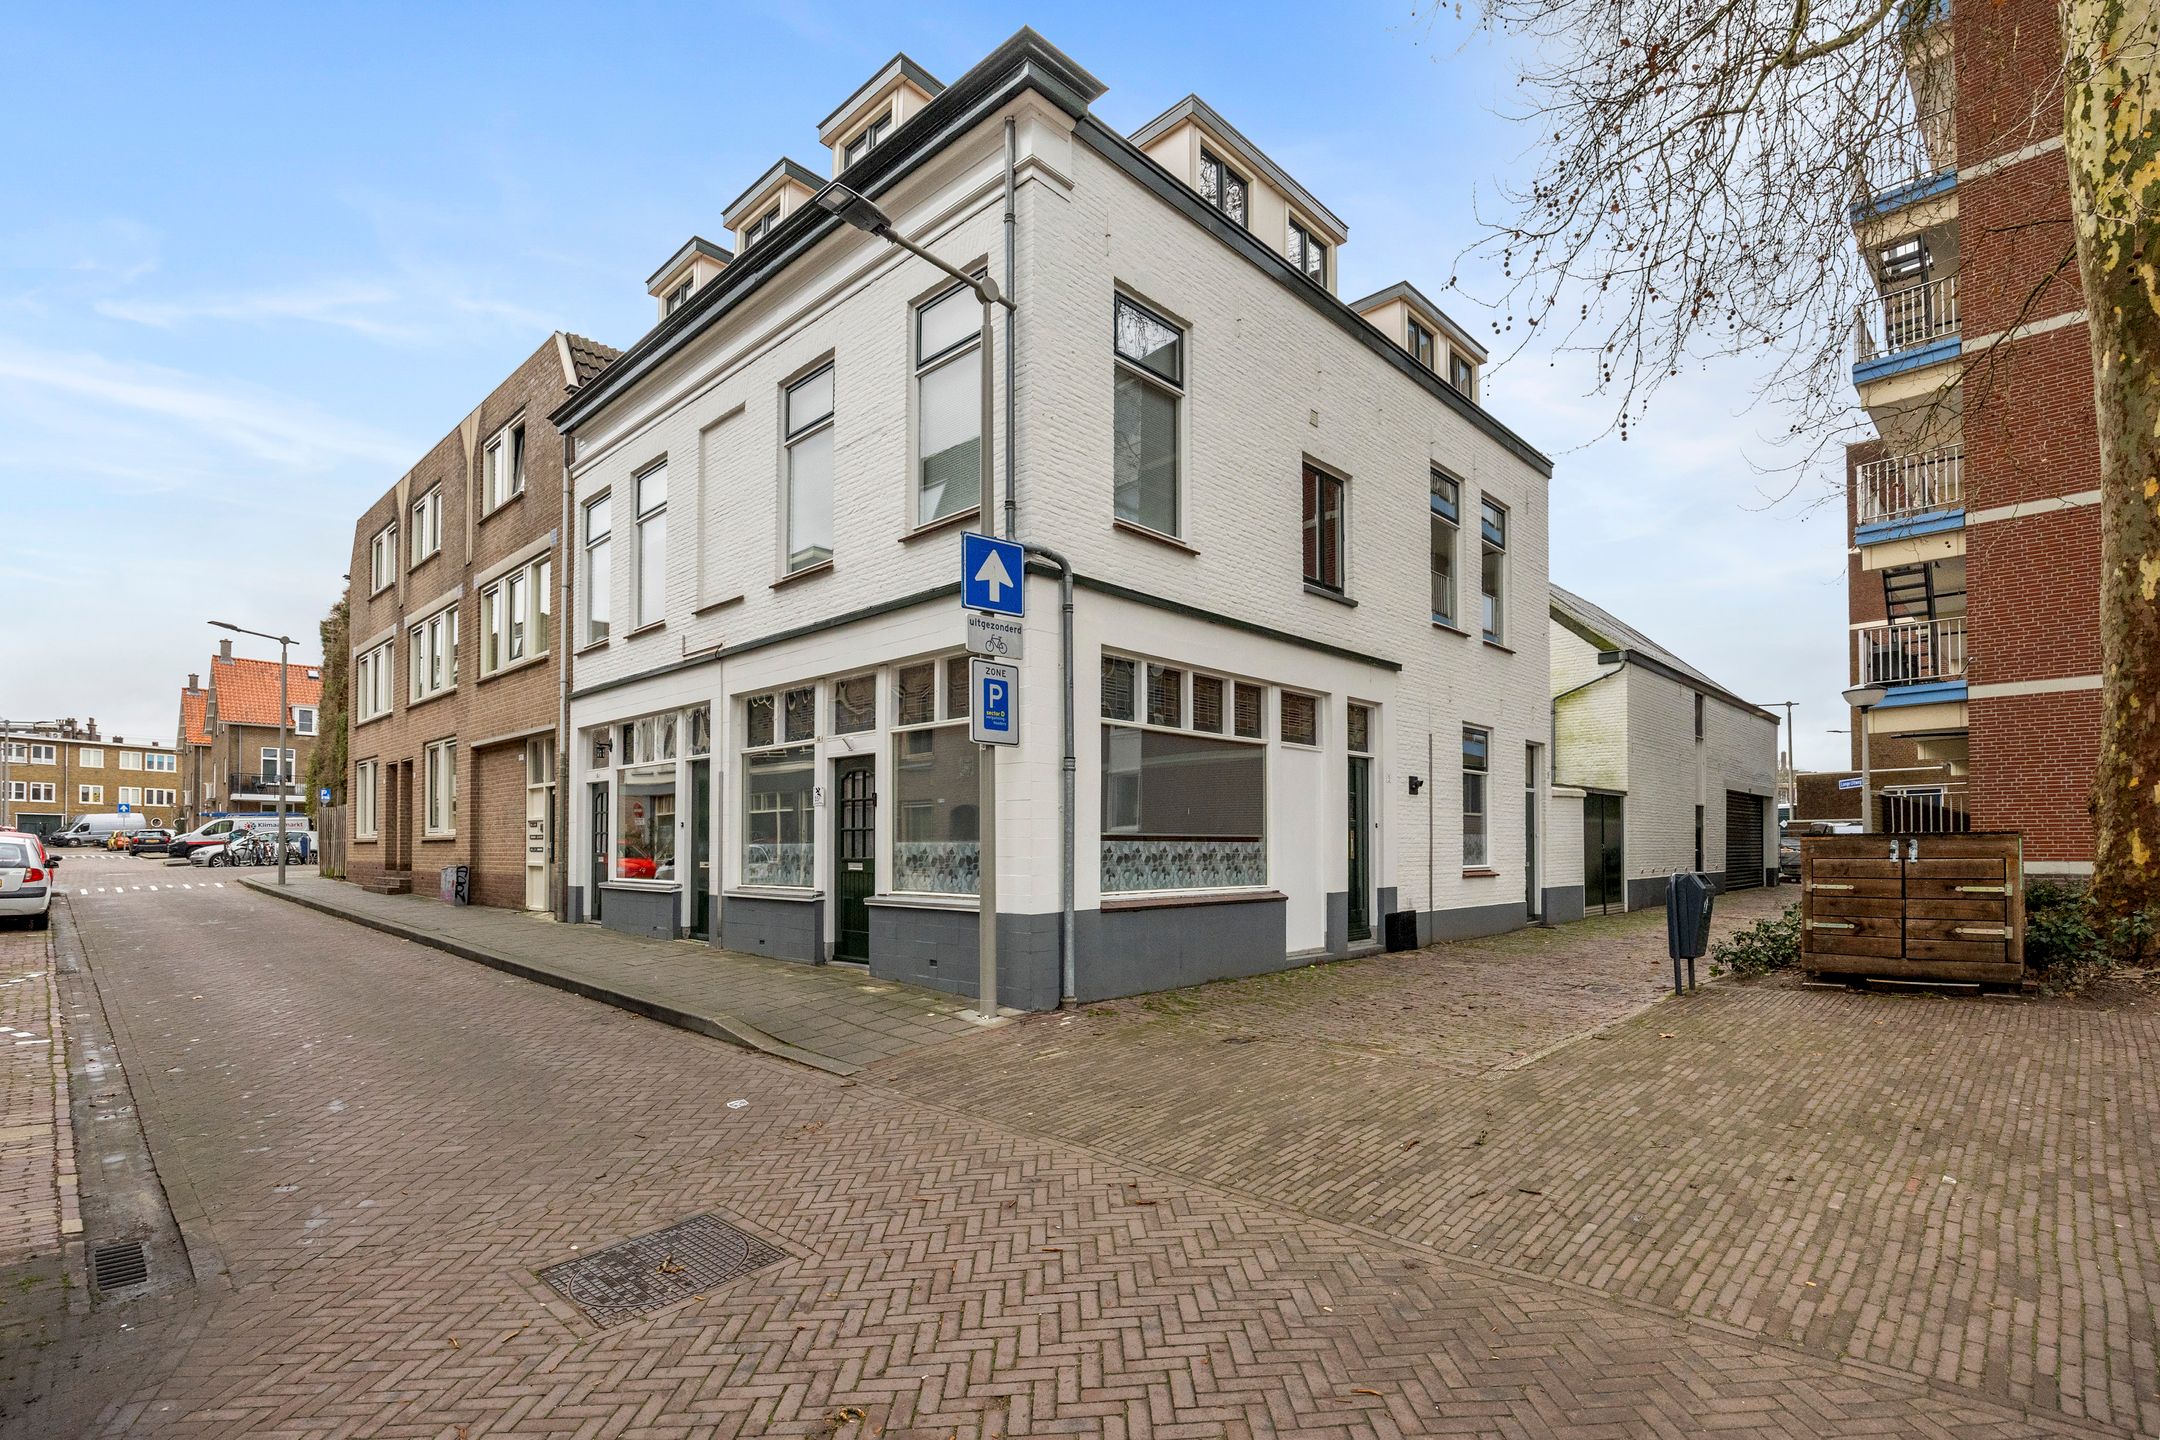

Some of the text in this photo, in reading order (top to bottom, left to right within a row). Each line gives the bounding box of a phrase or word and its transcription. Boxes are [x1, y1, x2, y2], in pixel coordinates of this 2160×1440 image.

[970, 618, 1022, 634] uitgezonderd
[985, 667, 1006, 678] ZONE
[989, 683, 1003, 709] P
